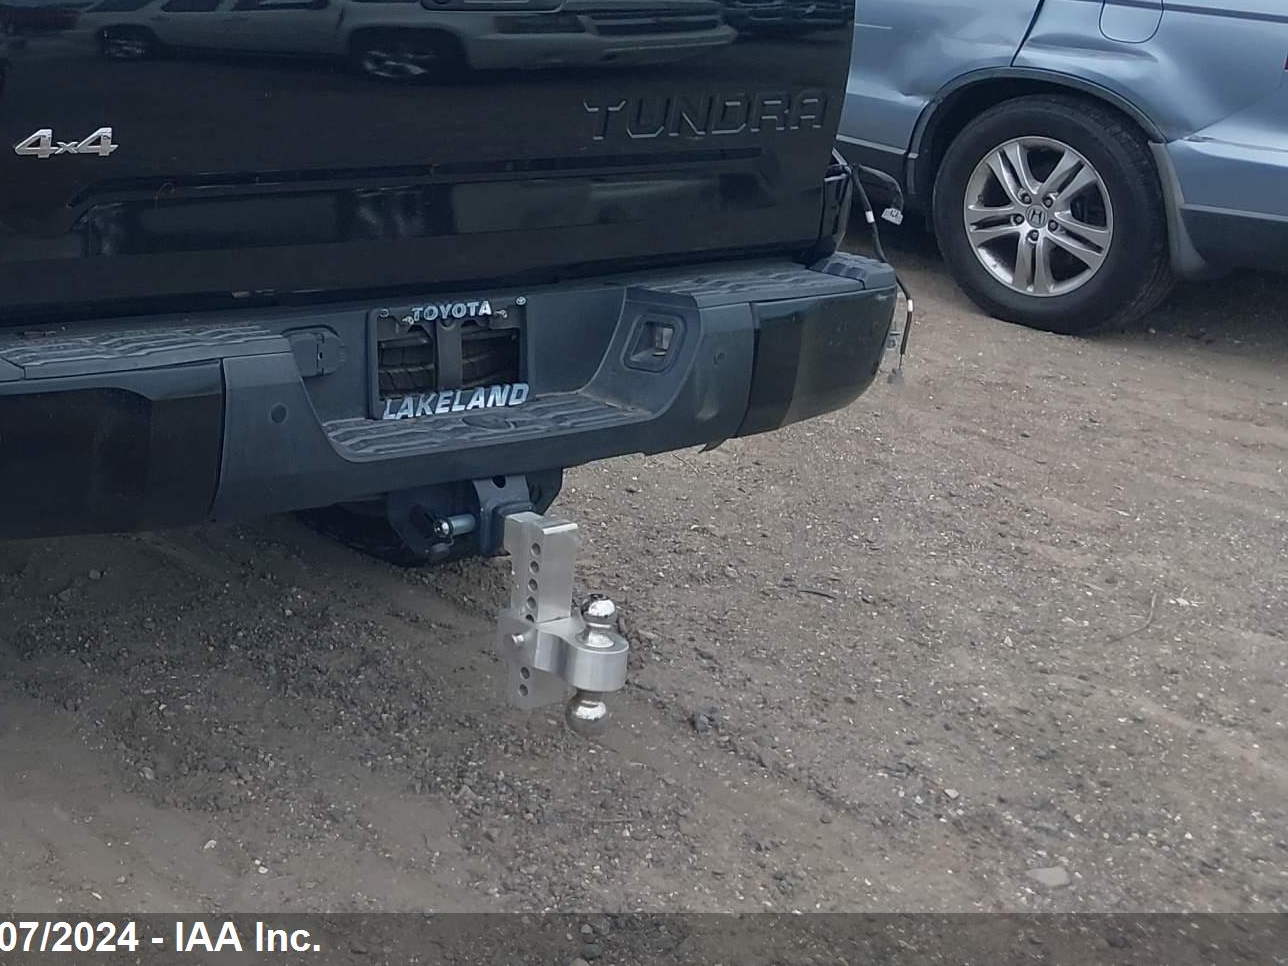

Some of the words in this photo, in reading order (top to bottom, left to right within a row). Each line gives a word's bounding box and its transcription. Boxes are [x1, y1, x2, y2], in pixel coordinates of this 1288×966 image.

[583, 91, 828, 141] TUNDRA
[412, 300, 492, 322] TOYOTA
[382, 383, 530, 420] LAKELAND
